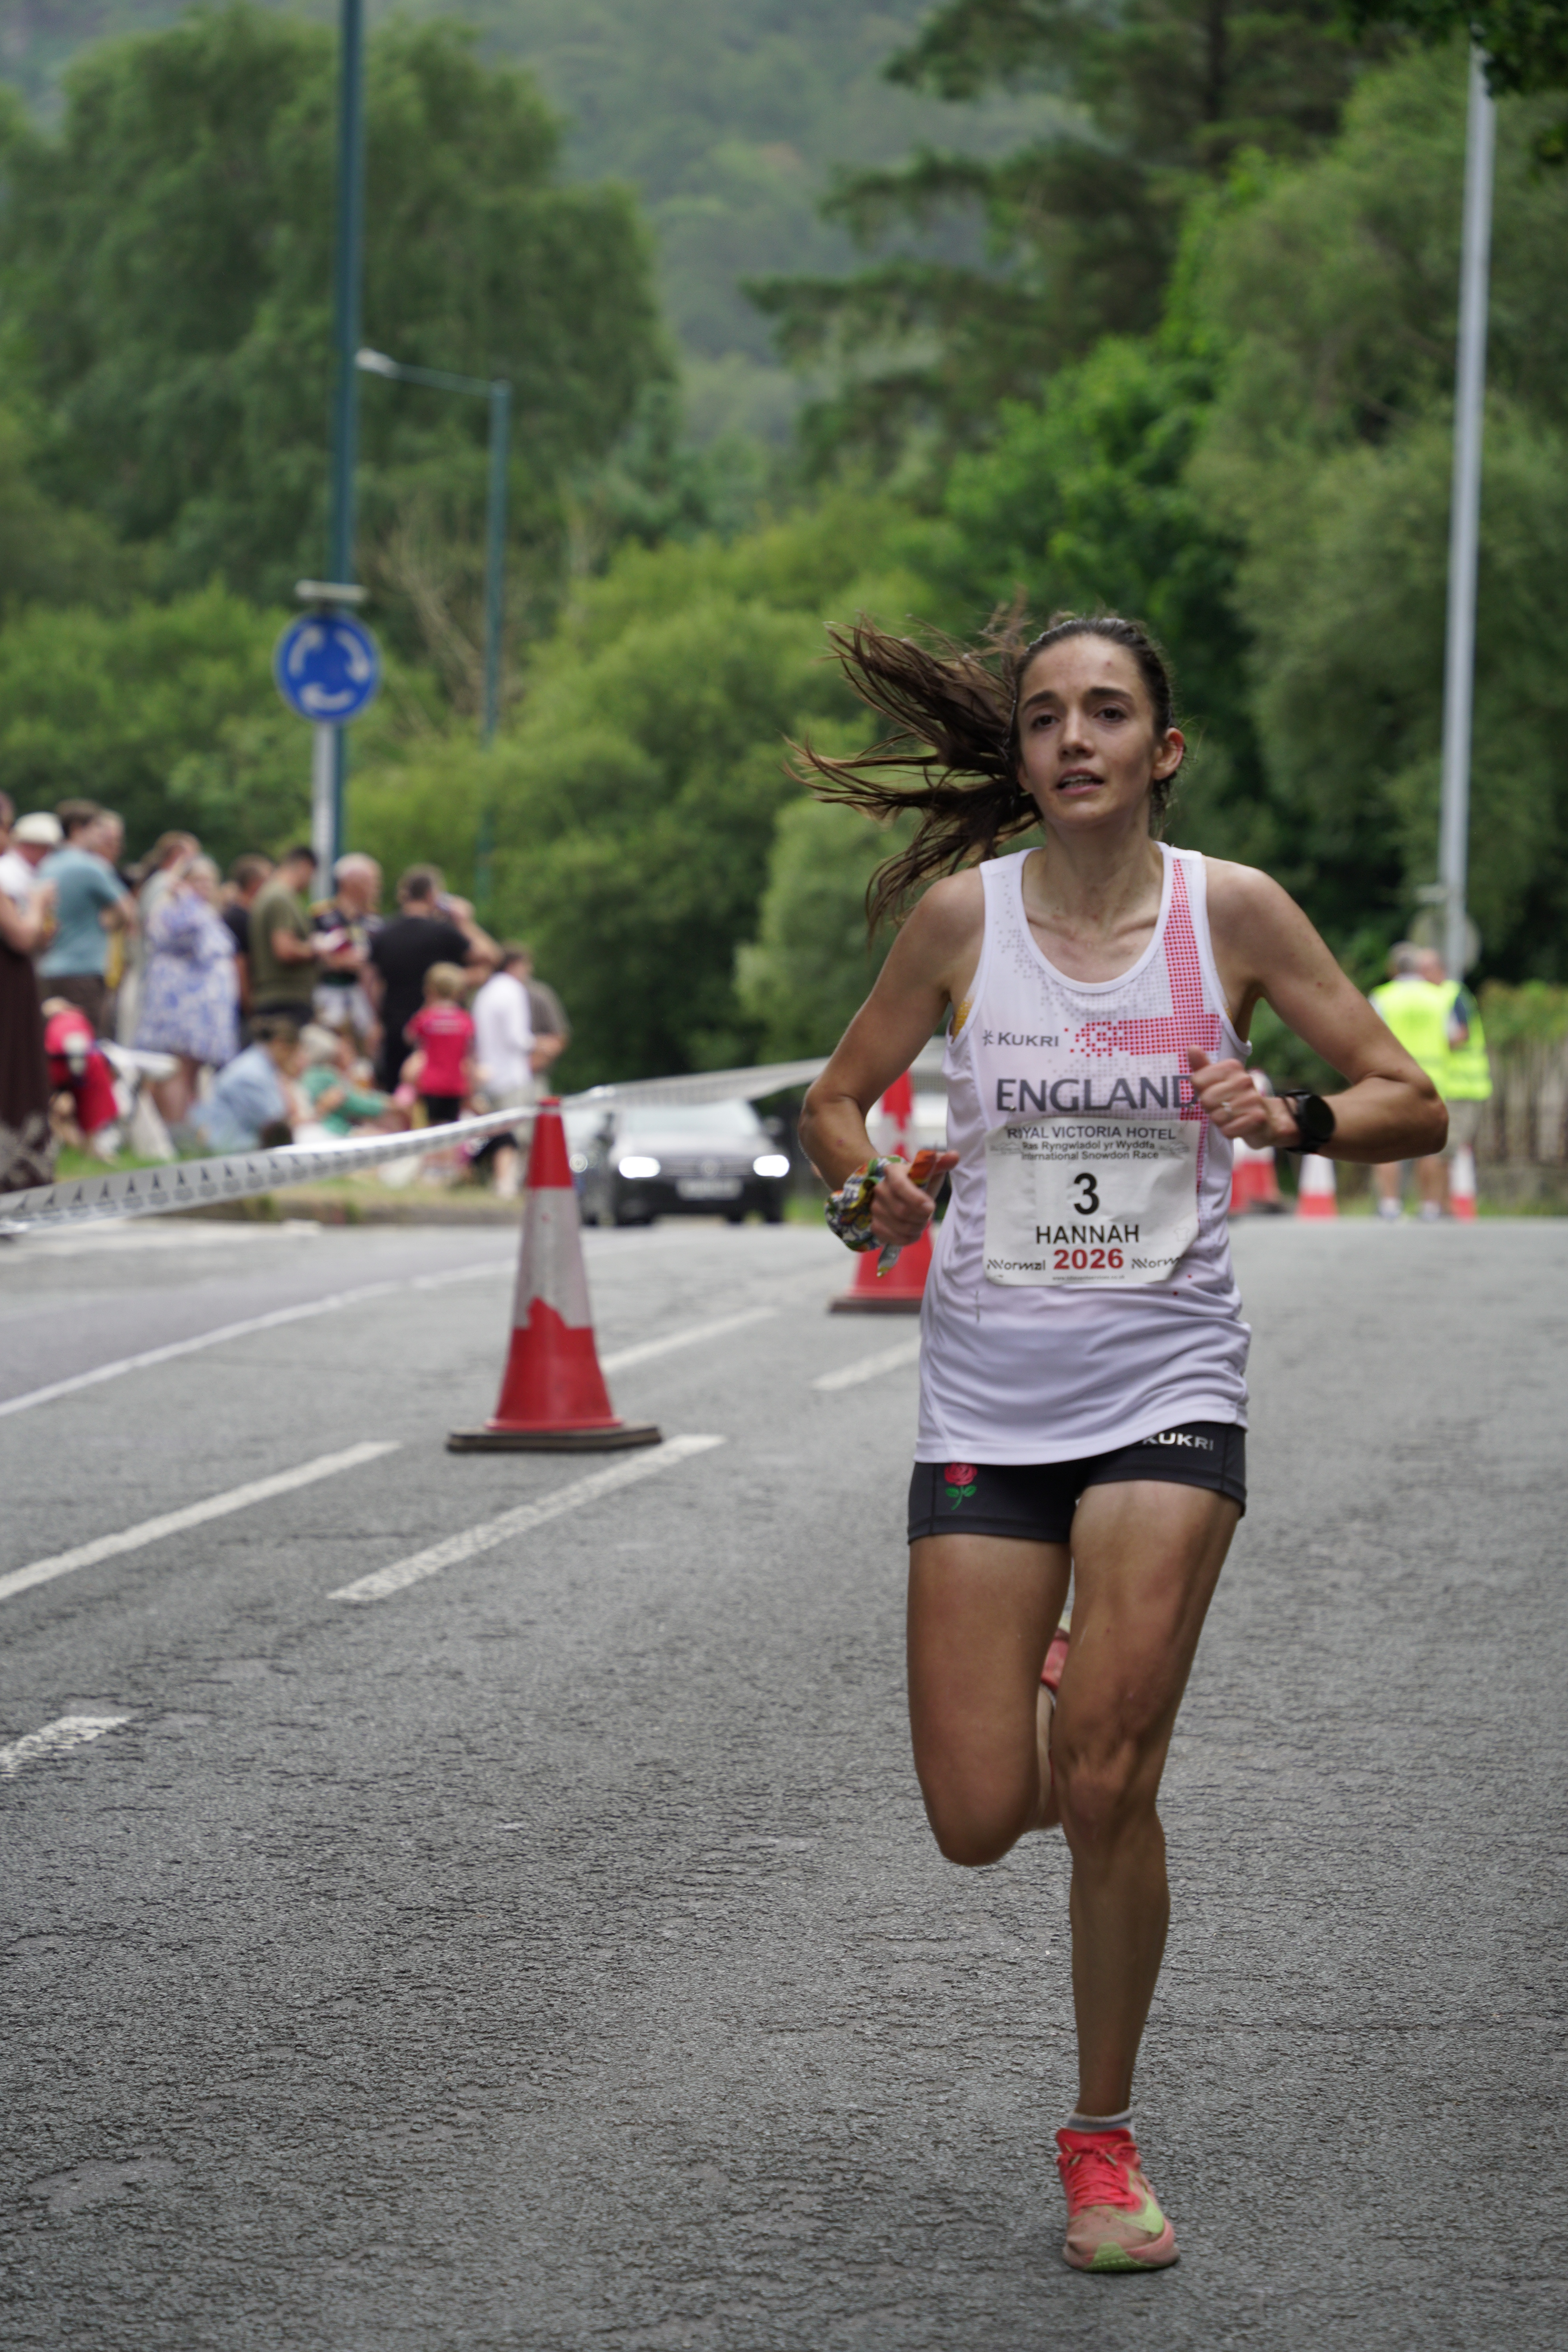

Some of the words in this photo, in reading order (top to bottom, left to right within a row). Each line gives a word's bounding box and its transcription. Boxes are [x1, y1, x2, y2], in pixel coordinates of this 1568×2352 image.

[998, 1032, 1059, 1047] KUKRI
[997, 1076, 1198, 1112] ENGLAND
[1051, 1125, 1122, 1138] VICTORIA
[1126, 1127, 1176, 1140] HOTEL
[1042, 1140, 1101, 1152] Ryngwladol
[1104, 1142, 1113, 1151] yr
[1116, 1140, 1155, 1151] Wyddfa
[1022, 1151, 1078, 1160] International
[1082, 1151, 1129, 1160] Snowdon
[1133, 1150, 1159, 1159] Race
[1073, 1172, 1099, 1215] 3
[1036, 1224, 1140, 1244] HANNAH
[1054, 1248, 1124, 1269] 2026
